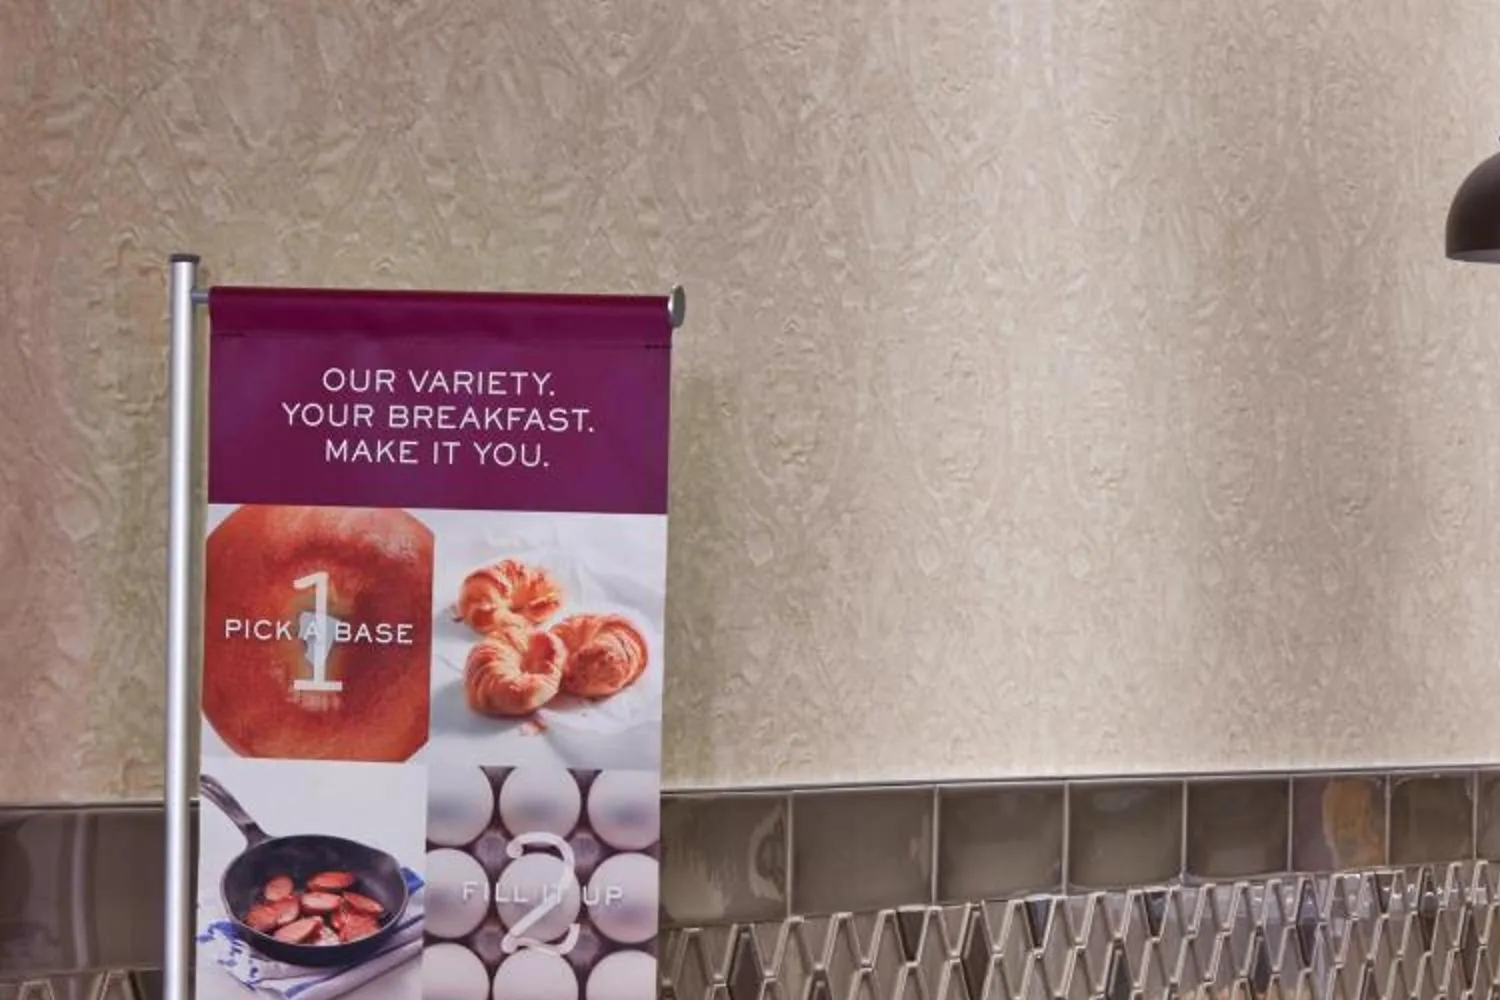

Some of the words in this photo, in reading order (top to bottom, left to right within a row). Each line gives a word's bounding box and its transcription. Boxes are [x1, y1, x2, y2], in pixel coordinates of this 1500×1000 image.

[323, 367, 395, 393] OUR
[407, 369, 555, 397] VARIETY.
[281, 402, 374, 427] YOUR
[388, 405, 595, 433] BREAKFAST.
[324, 439, 419, 465] MAKE
[433, 441, 461, 465] IT
[473, 442, 550, 468] YOU.
[224, 618, 292, 641] PICK
[303, 621, 320, 641] A
[335, 623, 413, 644] BASE
[293, 571, 343, 691] 1
[462, 881, 529, 903] FILL
[543, 884, 562, 904] IT
[583, 885, 623, 906] UP
[502, 832, 580, 955] 2
